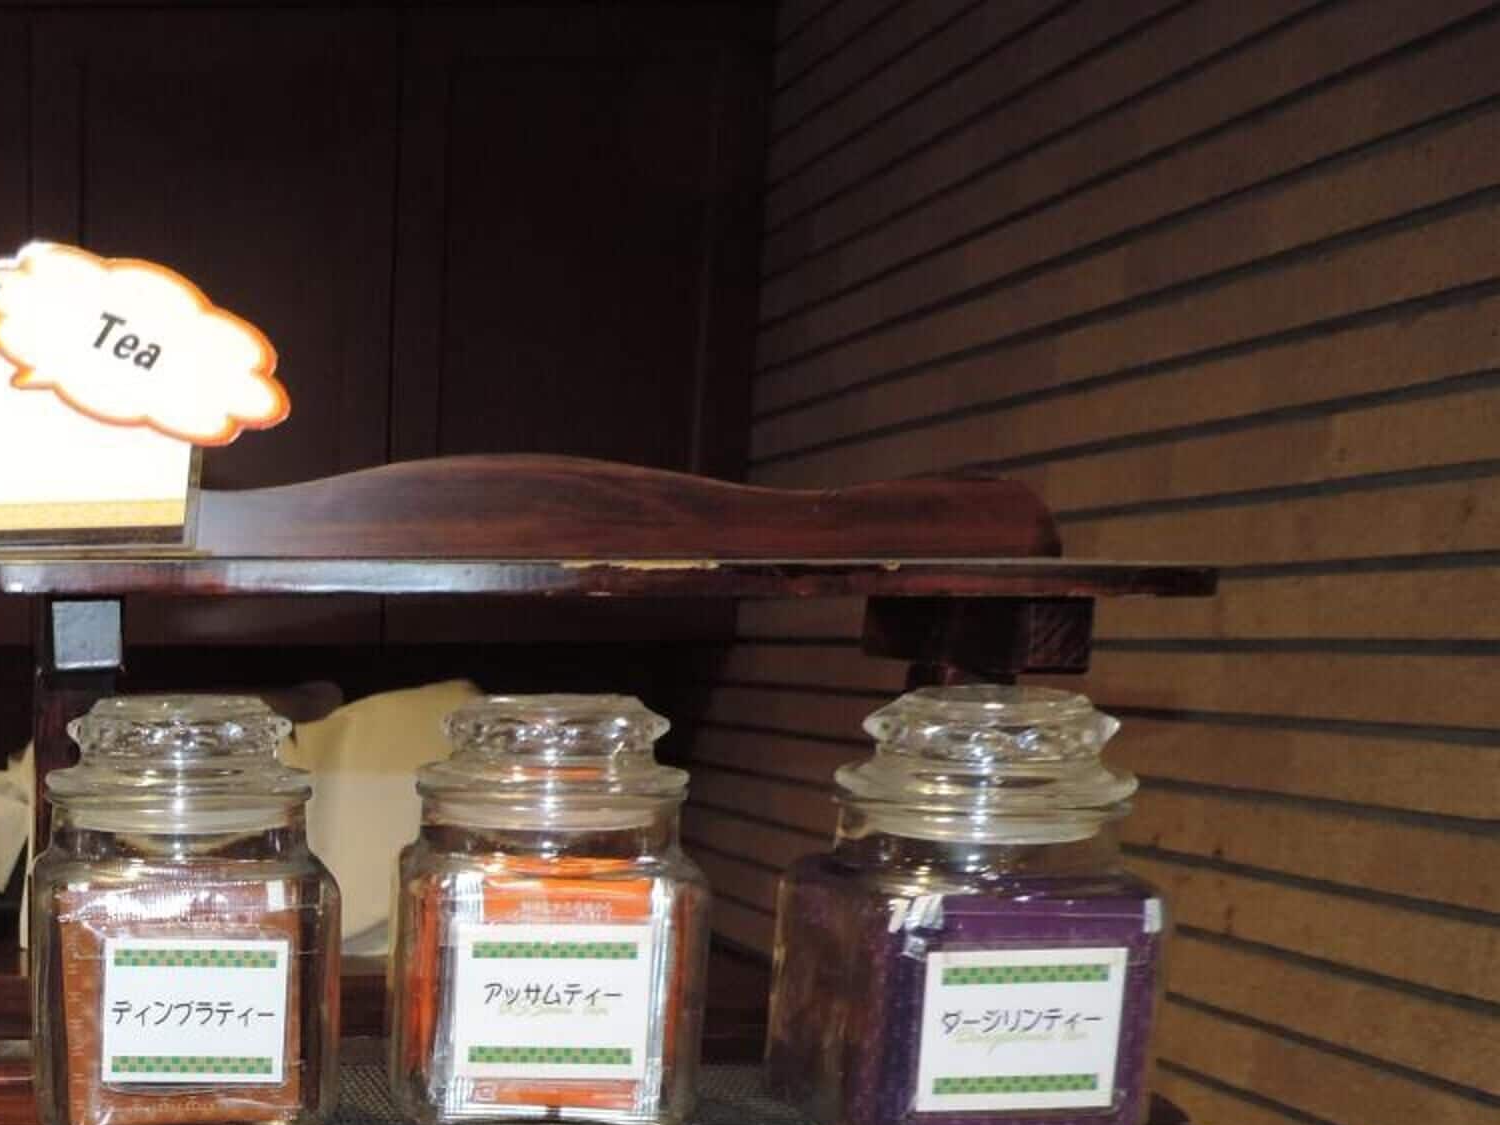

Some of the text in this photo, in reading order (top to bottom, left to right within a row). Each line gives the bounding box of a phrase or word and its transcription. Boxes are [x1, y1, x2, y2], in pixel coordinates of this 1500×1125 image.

[91, 312, 164, 373] Tea
[483, 983, 624, 1006] アッサムティー
[941, 1007, 1104, 1035] ダージリンティー
